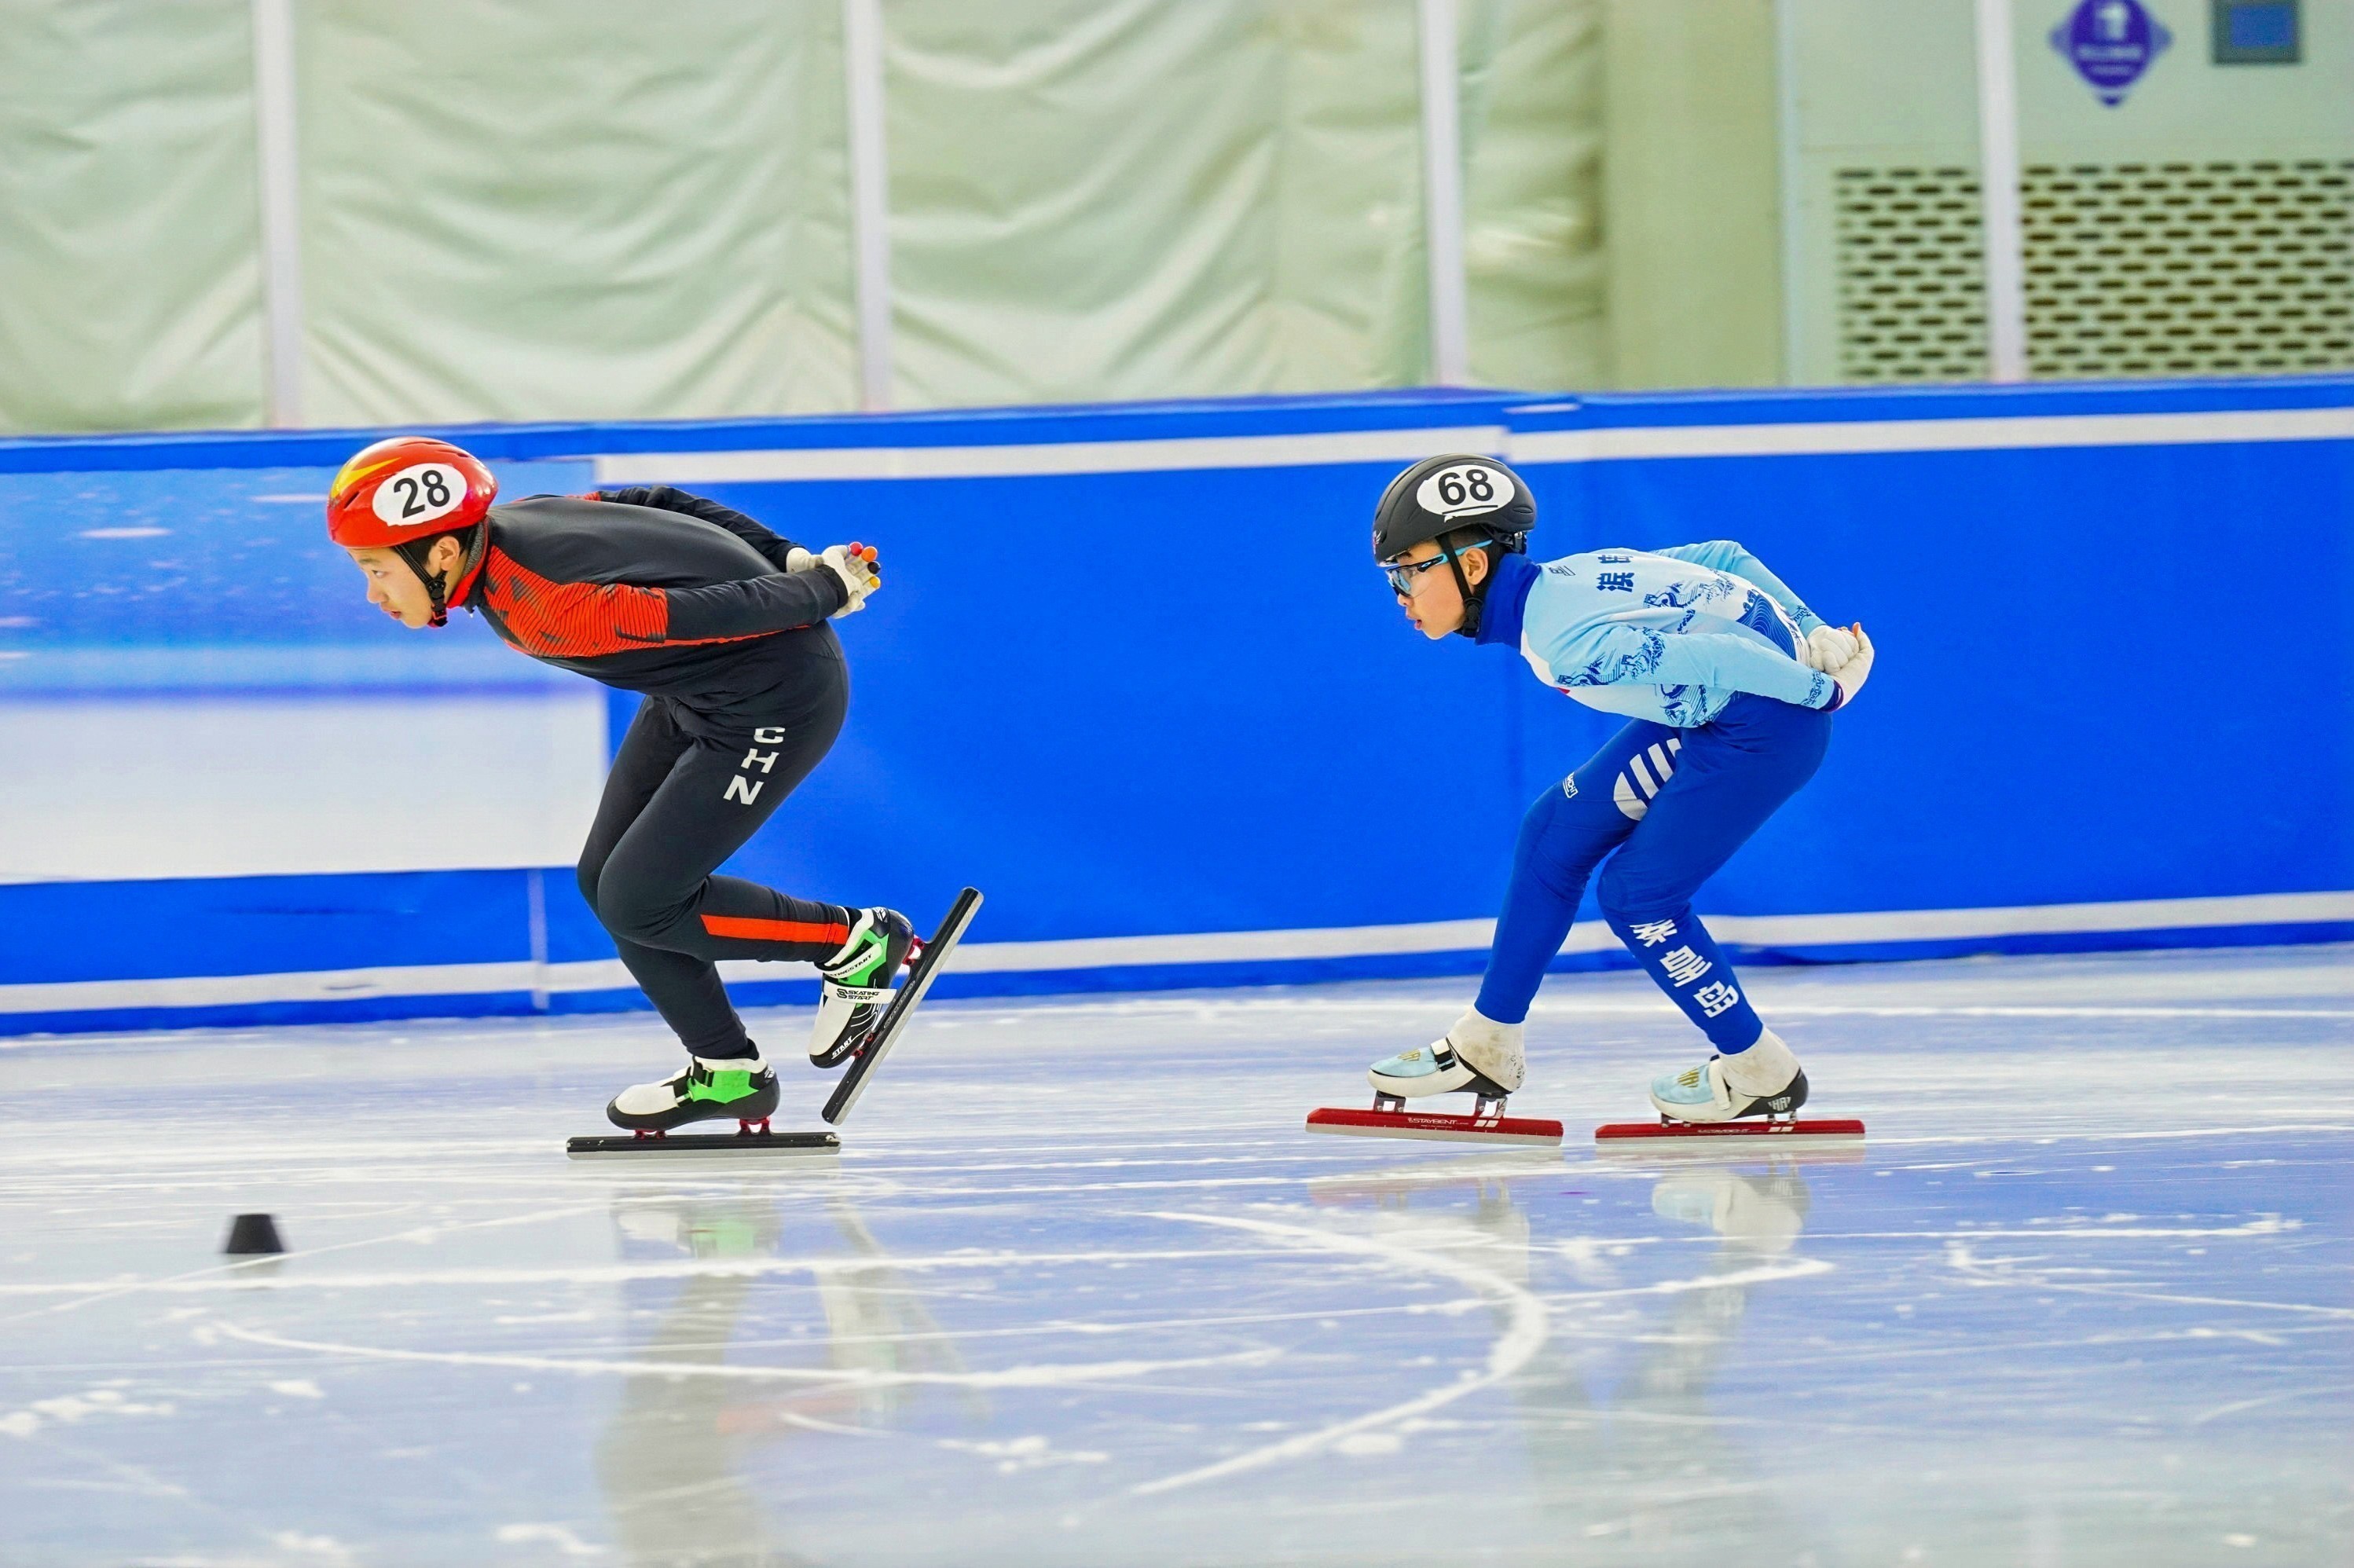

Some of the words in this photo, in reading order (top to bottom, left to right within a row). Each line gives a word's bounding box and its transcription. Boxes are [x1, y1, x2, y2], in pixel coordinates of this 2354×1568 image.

[394, 470, 450, 518] 28
[1438, 469, 1494, 506] 68
[723, 727, 786, 805] CHN
[1629, 918, 1740, 1018] 秦皇岛
[831, 1035, 853, 1058] START
